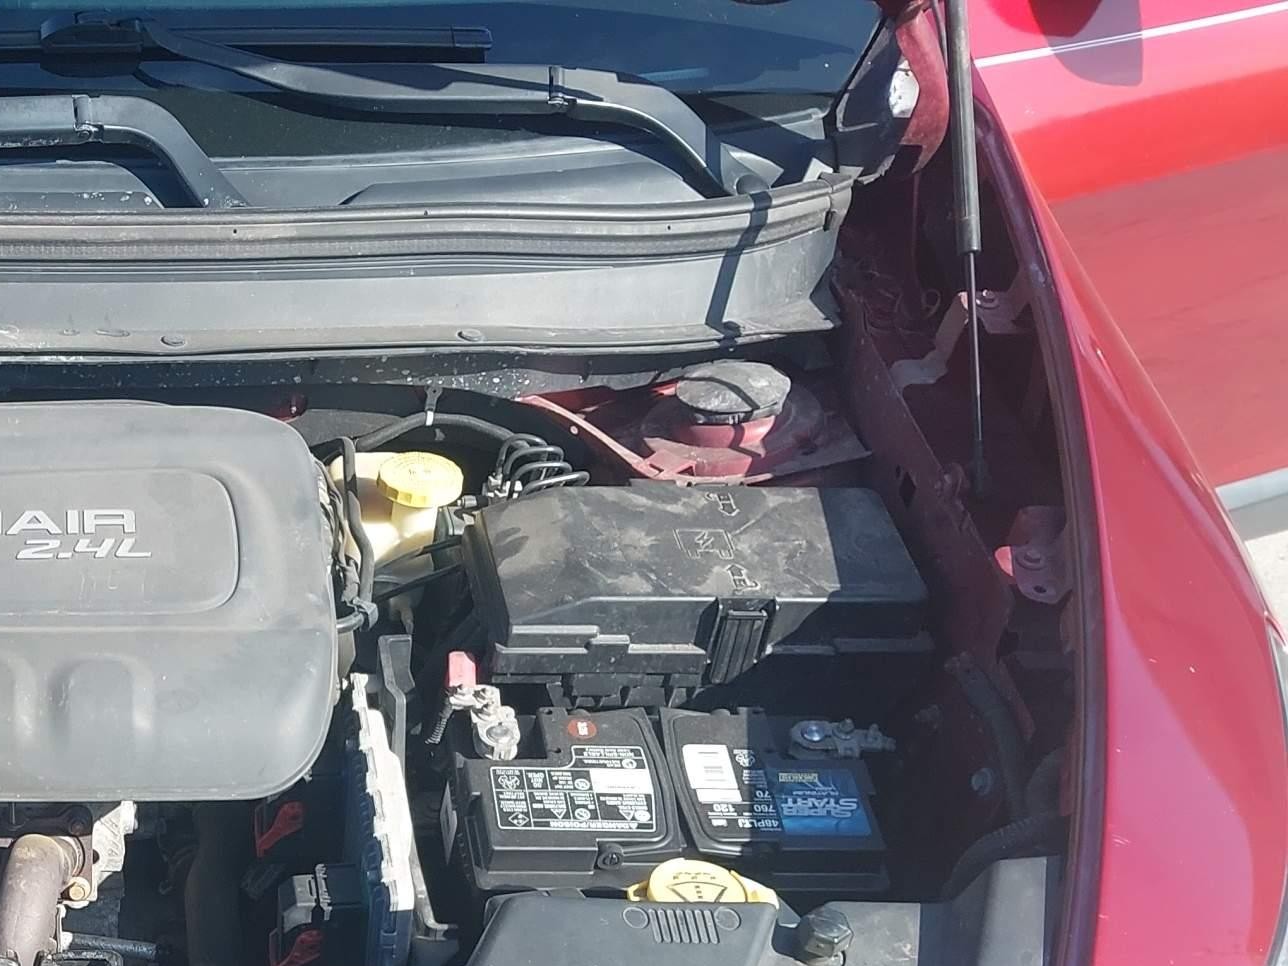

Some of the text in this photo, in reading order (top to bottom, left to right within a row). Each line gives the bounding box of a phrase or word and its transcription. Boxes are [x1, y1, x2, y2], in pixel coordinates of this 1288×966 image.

[16, 537, 152, 560] 2.4L
[756, 790, 772, 798] 70
[713, 803, 736, 813] 120
[753, 804, 777, 813] 760
[782, 797, 857, 810] START
[782, 805, 851, 818] SUPER
